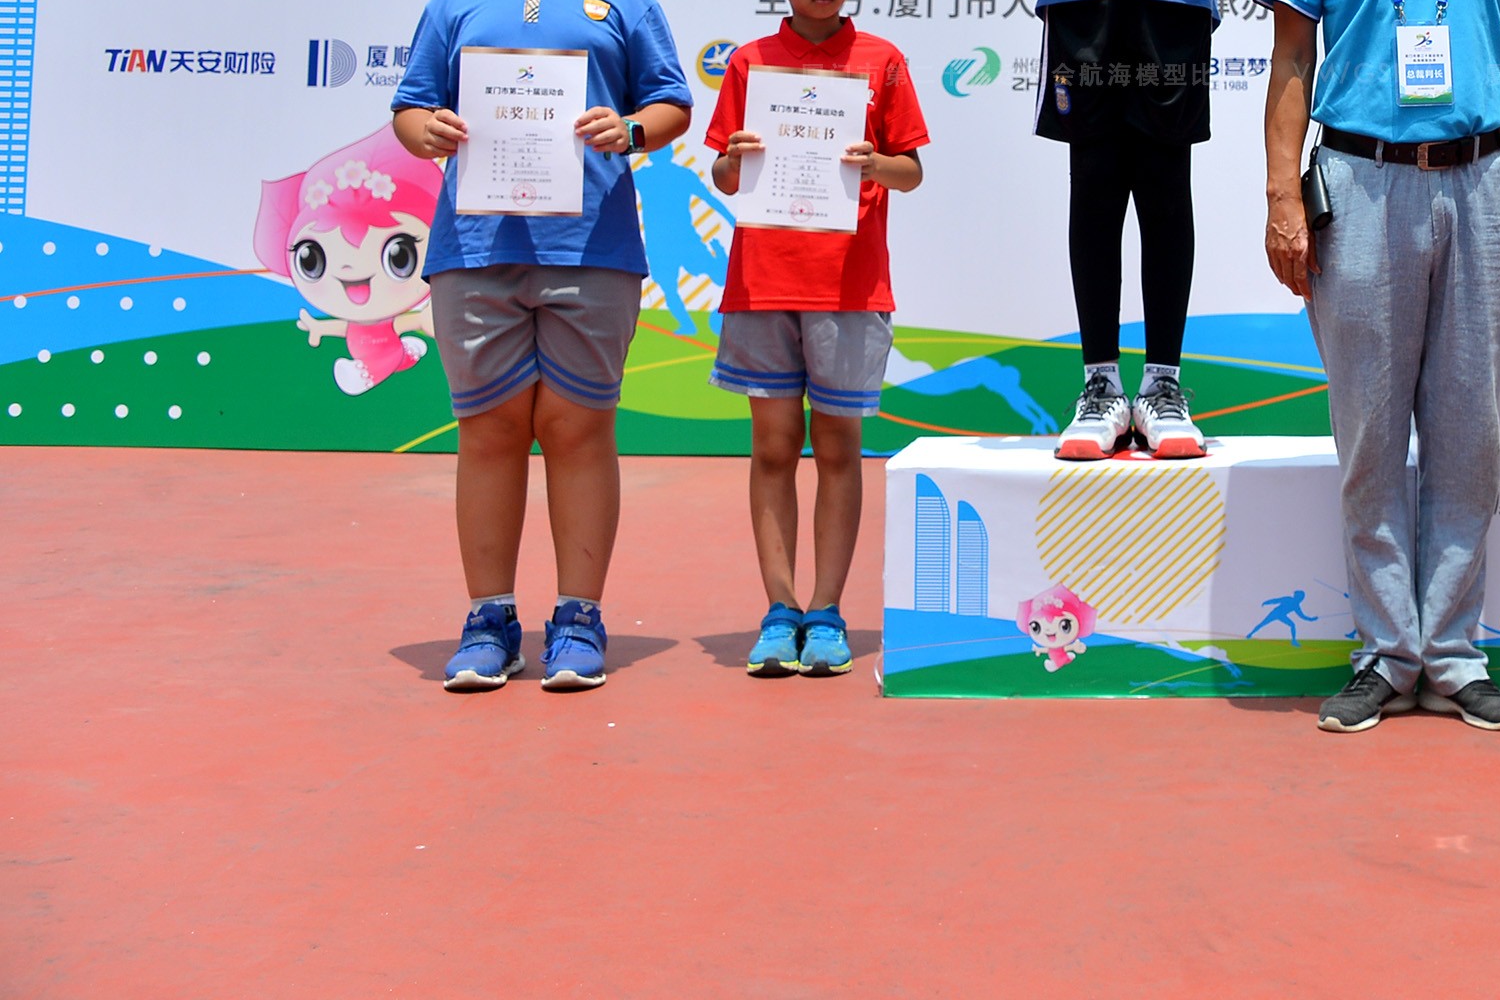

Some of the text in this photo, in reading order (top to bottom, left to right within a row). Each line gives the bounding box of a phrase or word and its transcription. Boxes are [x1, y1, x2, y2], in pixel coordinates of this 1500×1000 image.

[169, 50, 276, 75] 天安财险
[1224, 57, 1272, 77] 喜梦
[1223, 81, 1248, 91] 1988
